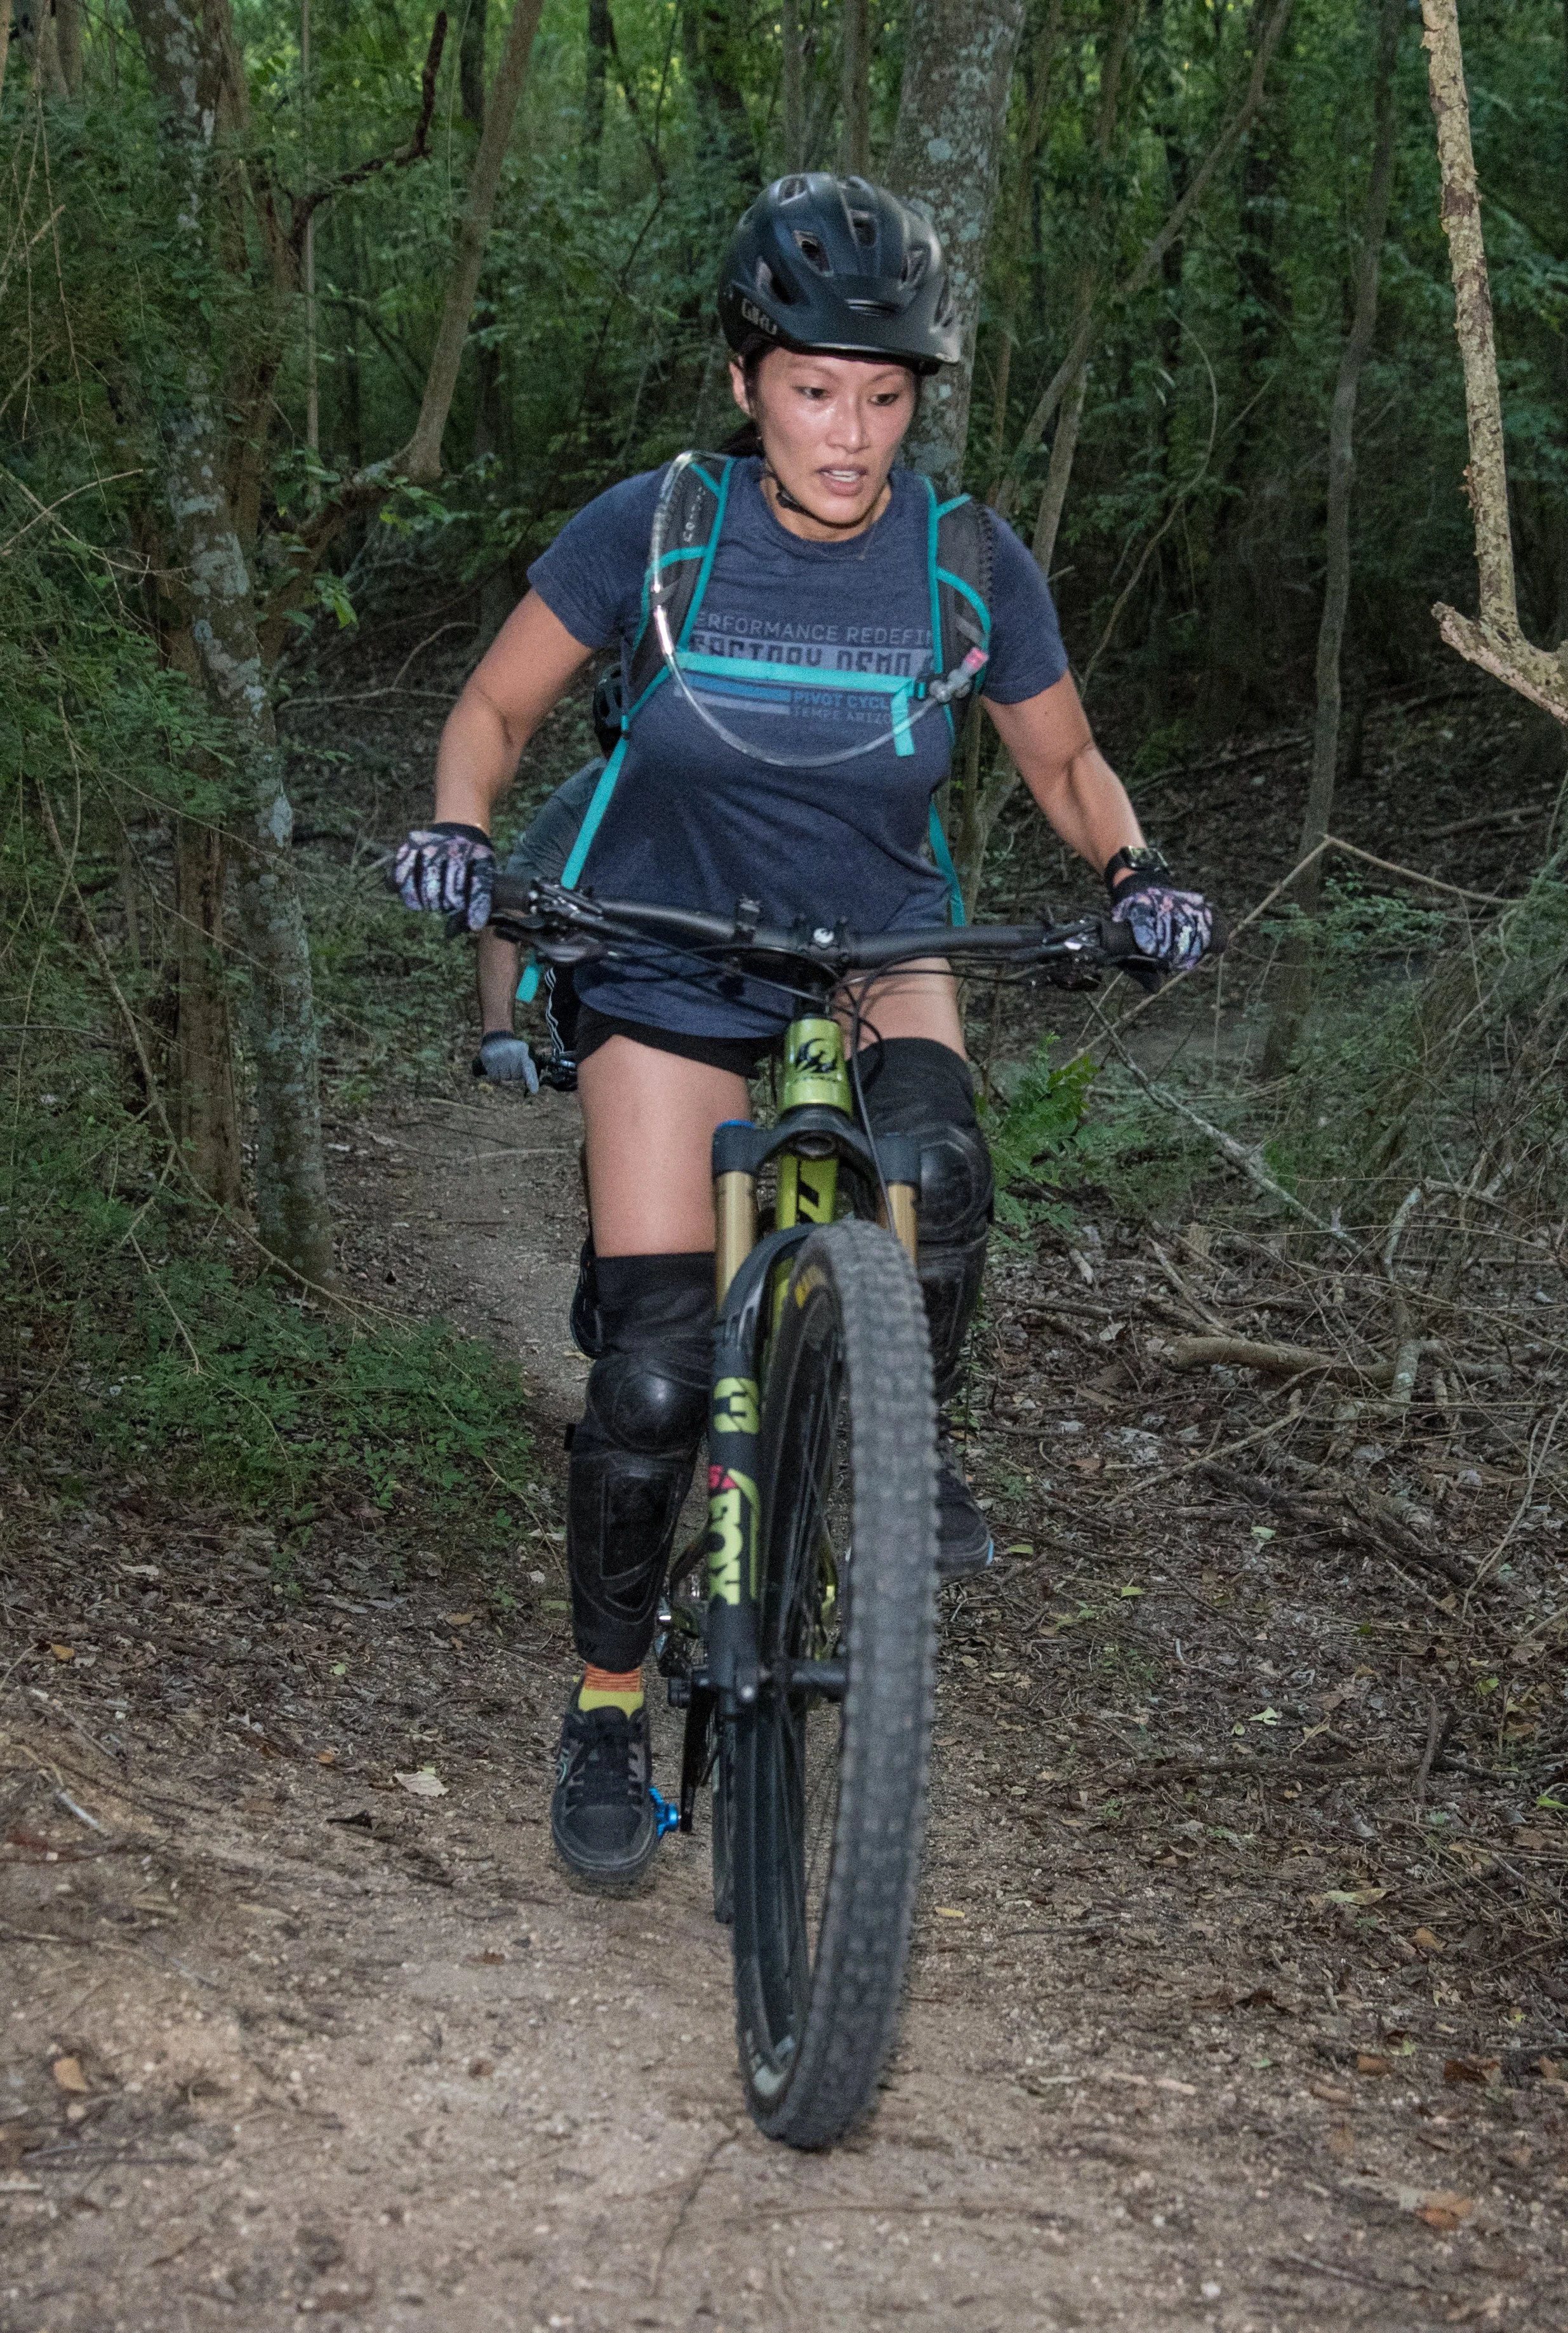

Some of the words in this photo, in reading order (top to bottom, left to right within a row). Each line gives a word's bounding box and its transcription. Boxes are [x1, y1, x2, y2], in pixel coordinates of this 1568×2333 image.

[696, 612, 839, 642] ERFORMANCE
[846, 627, 931, 646] REDEFI
[794, 690, 842, 707] PIVOT
[847, 695, 889, 710] CYCL
[847, 712, 891, 724] ARIZO
